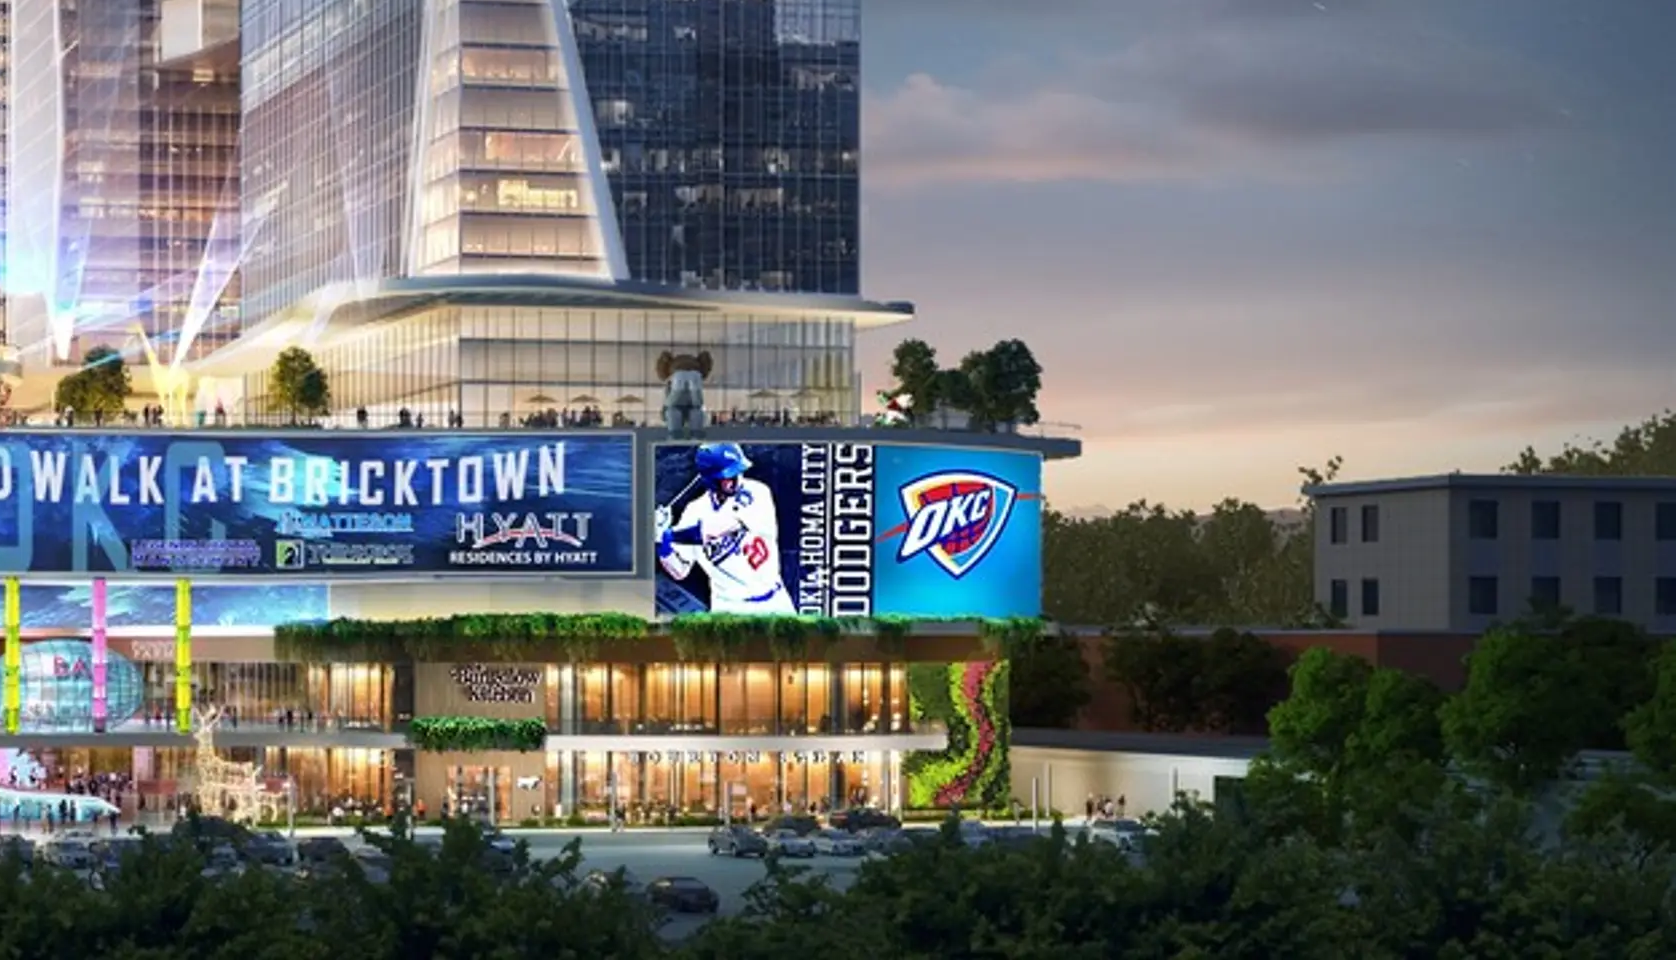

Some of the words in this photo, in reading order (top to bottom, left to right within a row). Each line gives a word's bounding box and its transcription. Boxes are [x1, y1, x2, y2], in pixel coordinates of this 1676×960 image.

[30, 450, 165, 506] WALK
[190, 455, 249, 504] AT
[267, 441, 567, 507] BRICKTOWN
[800, 443, 826, 495] CITY
[455, 511, 594, 548] HYATT
[832, 443, 874, 618] DODGERS
[900, 487, 992, 557] OKC
[448, 551, 532, 565] RESIDENCES
[533, 551, 551, 565] BY
[554, 551, 599, 565] HYATT
